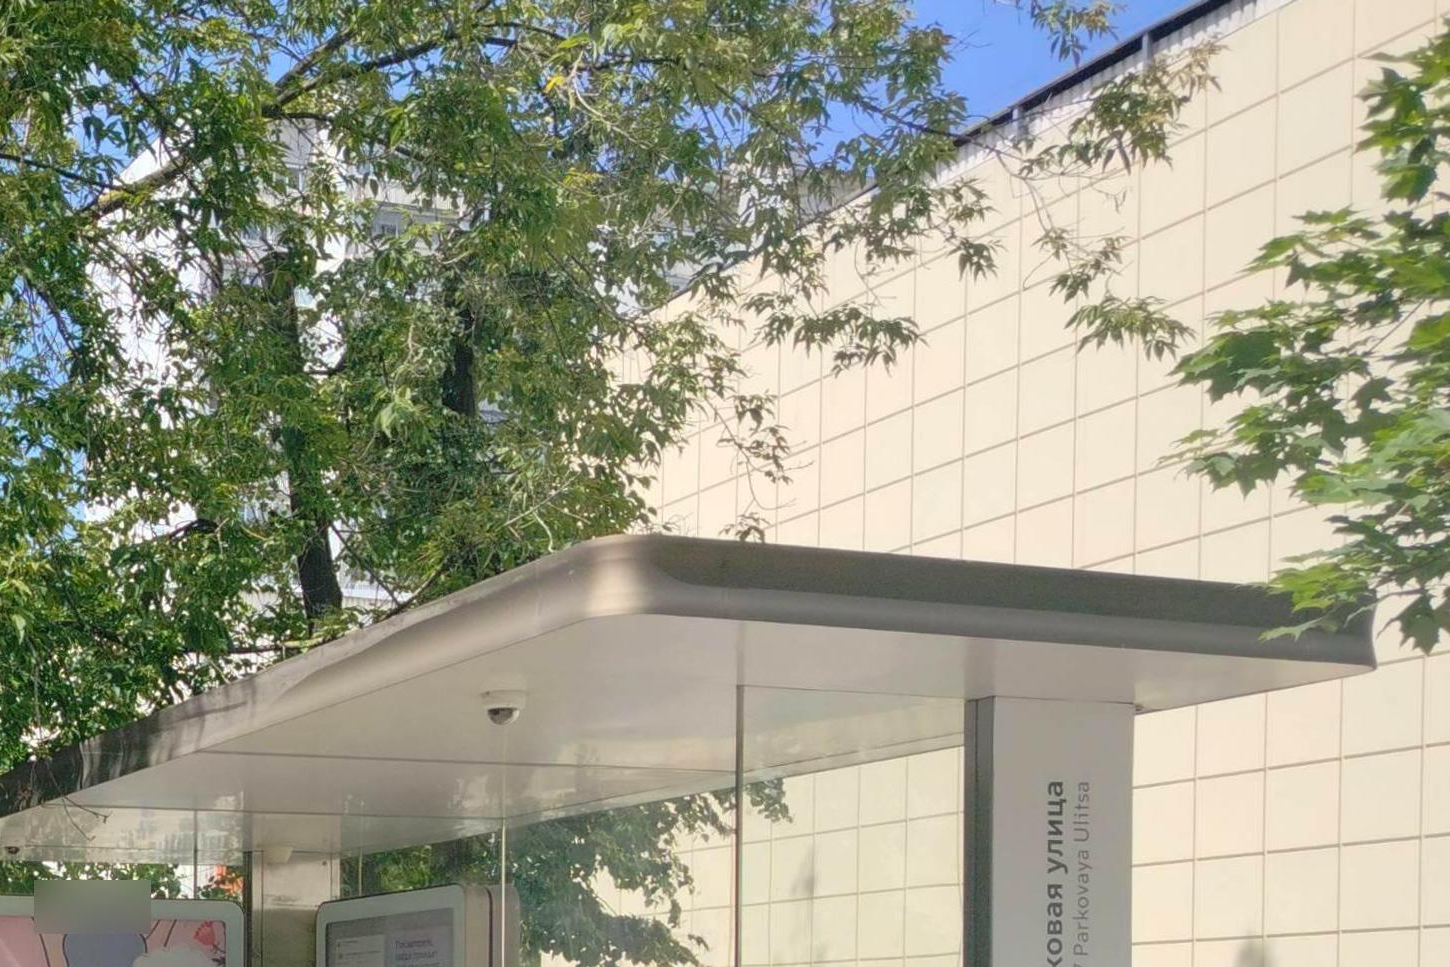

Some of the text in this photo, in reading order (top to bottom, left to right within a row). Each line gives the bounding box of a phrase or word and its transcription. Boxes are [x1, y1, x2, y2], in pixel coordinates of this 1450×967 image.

[1047, 781, 1069, 875] улица
[1073, 781, 1090, 842] Ulitsa
[1073, 849, 1094, 957] Parkovaya
